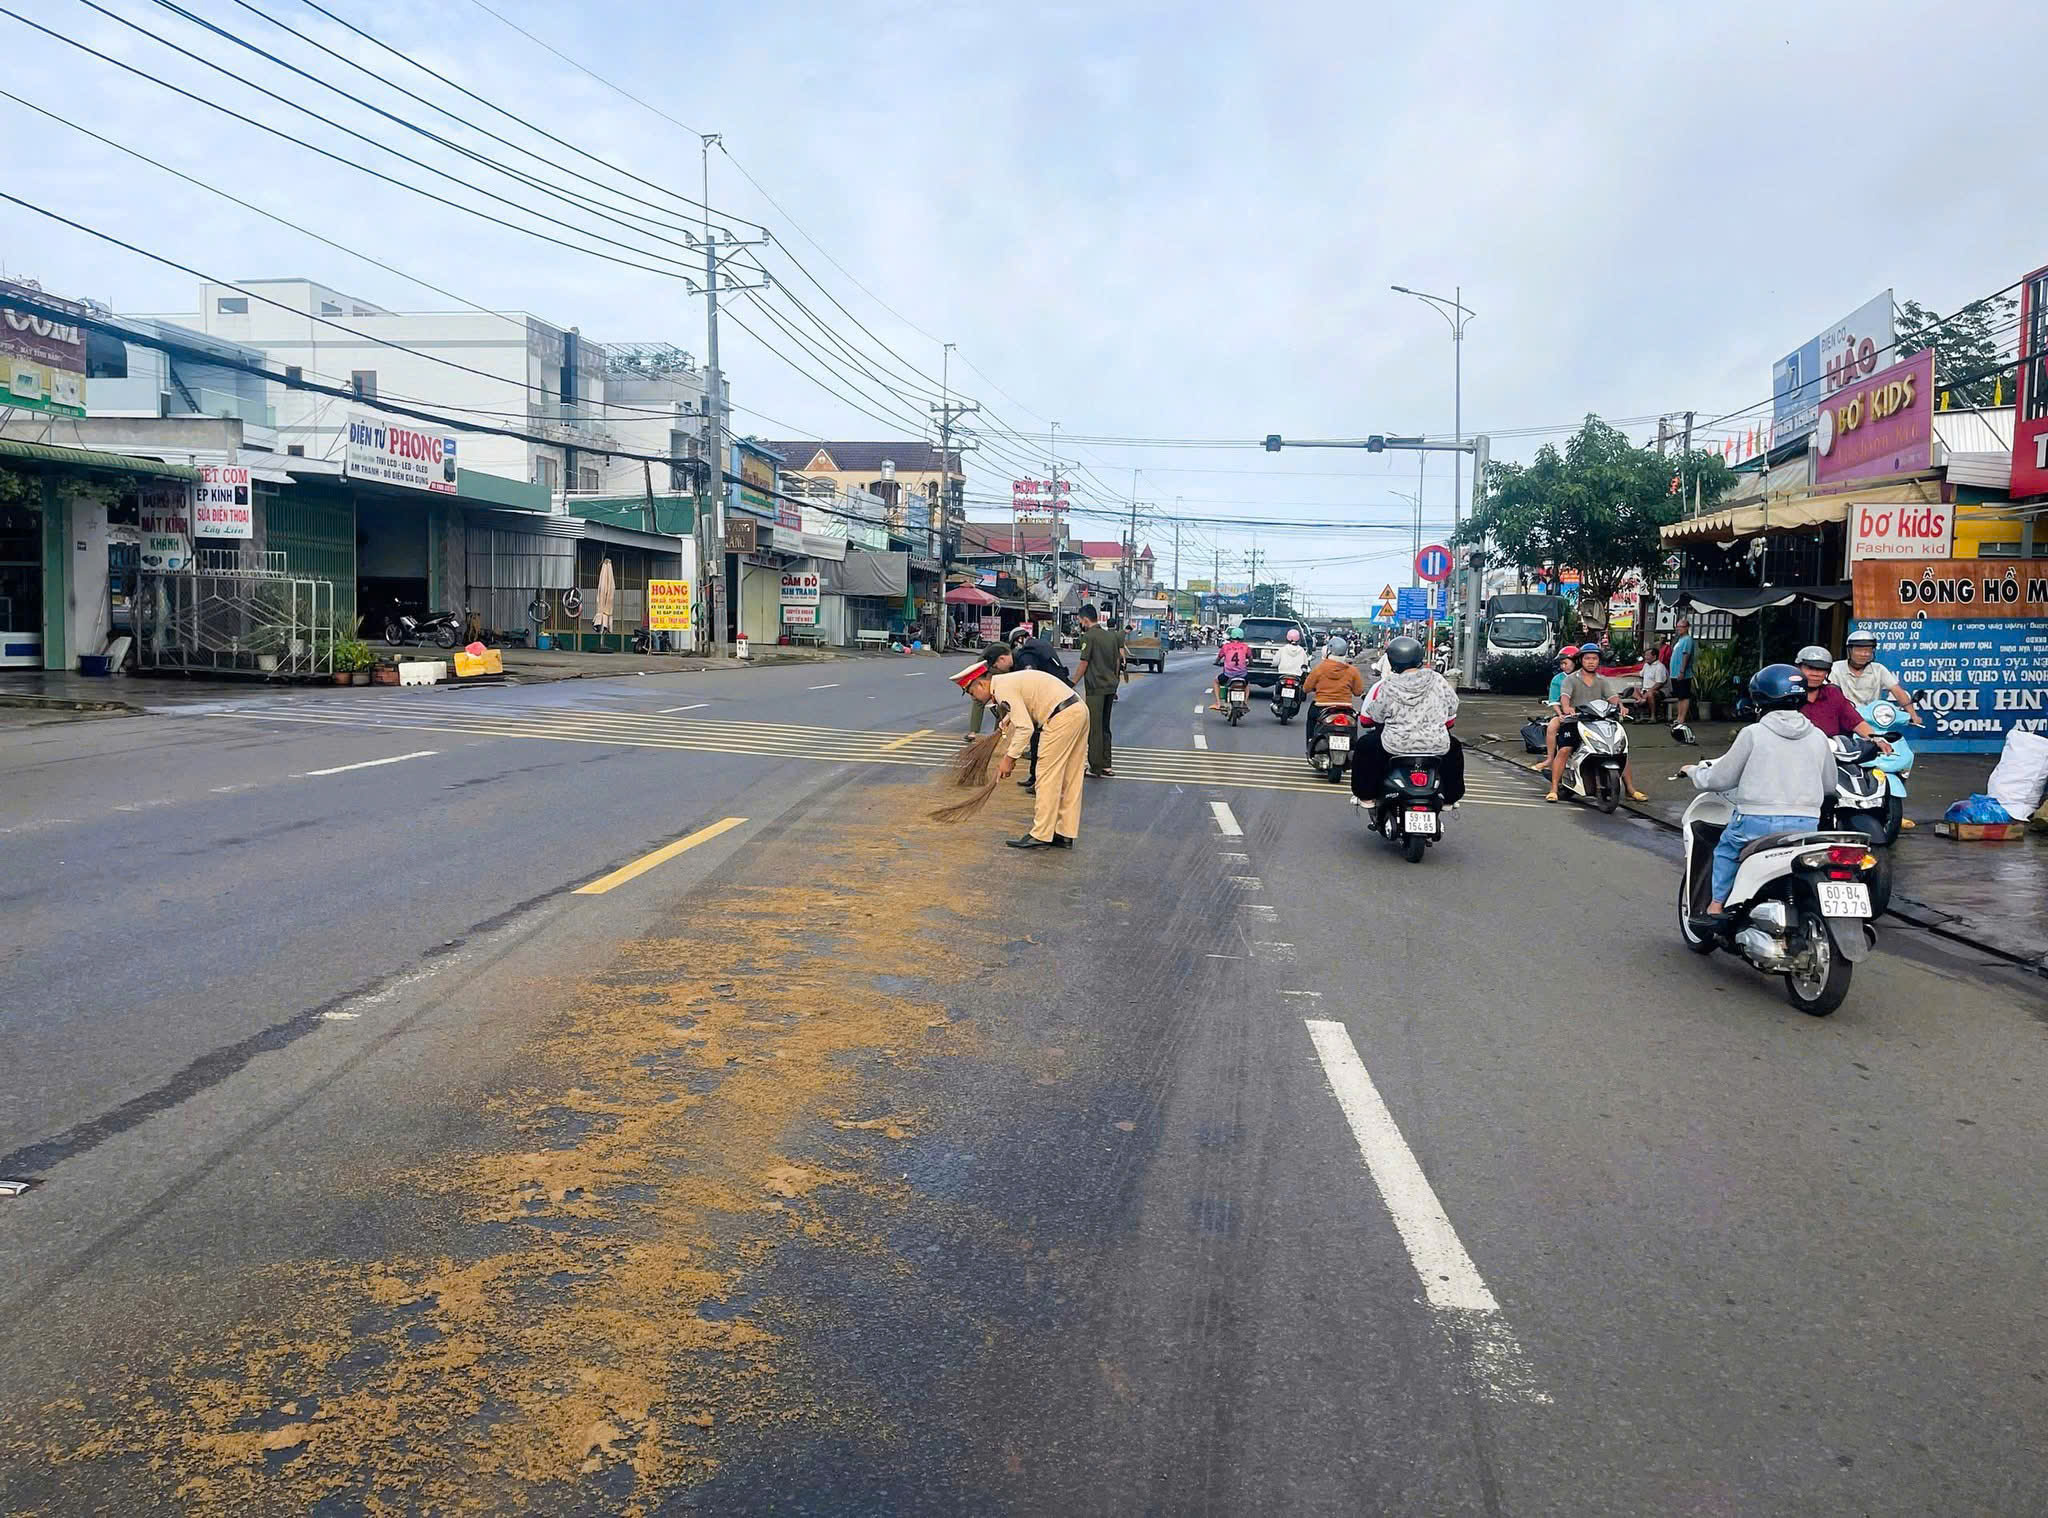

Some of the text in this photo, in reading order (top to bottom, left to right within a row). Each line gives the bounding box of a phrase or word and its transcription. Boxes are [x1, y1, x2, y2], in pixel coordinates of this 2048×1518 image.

[1826, 334, 1878, 392] HẢO
[1871, 373, 1917, 422] KIDS
[350, 420, 372, 450] ĐIỆN
[389, 427, 443, 464] PHONG
[1859, 508, 1945, 538] bơ kids
[1856, 542, 1945, 554] Fashion kid
[804, 573, 817, 587] ĐỒ
[1899, 566, 1975, 604] ĐỒNG
[1983, 566, 2020, 604] HỒ
[651, 582, 688, 596] HOÀNG
[1231, 652, 1240, 667] 4
[1901, 659, 1925, 667] GPP
[1904, 671, 1926, 682] CHO
[1931, 668, 1962, 684] BỆNH
[1937, 719, 2003, 736] THUỐC
